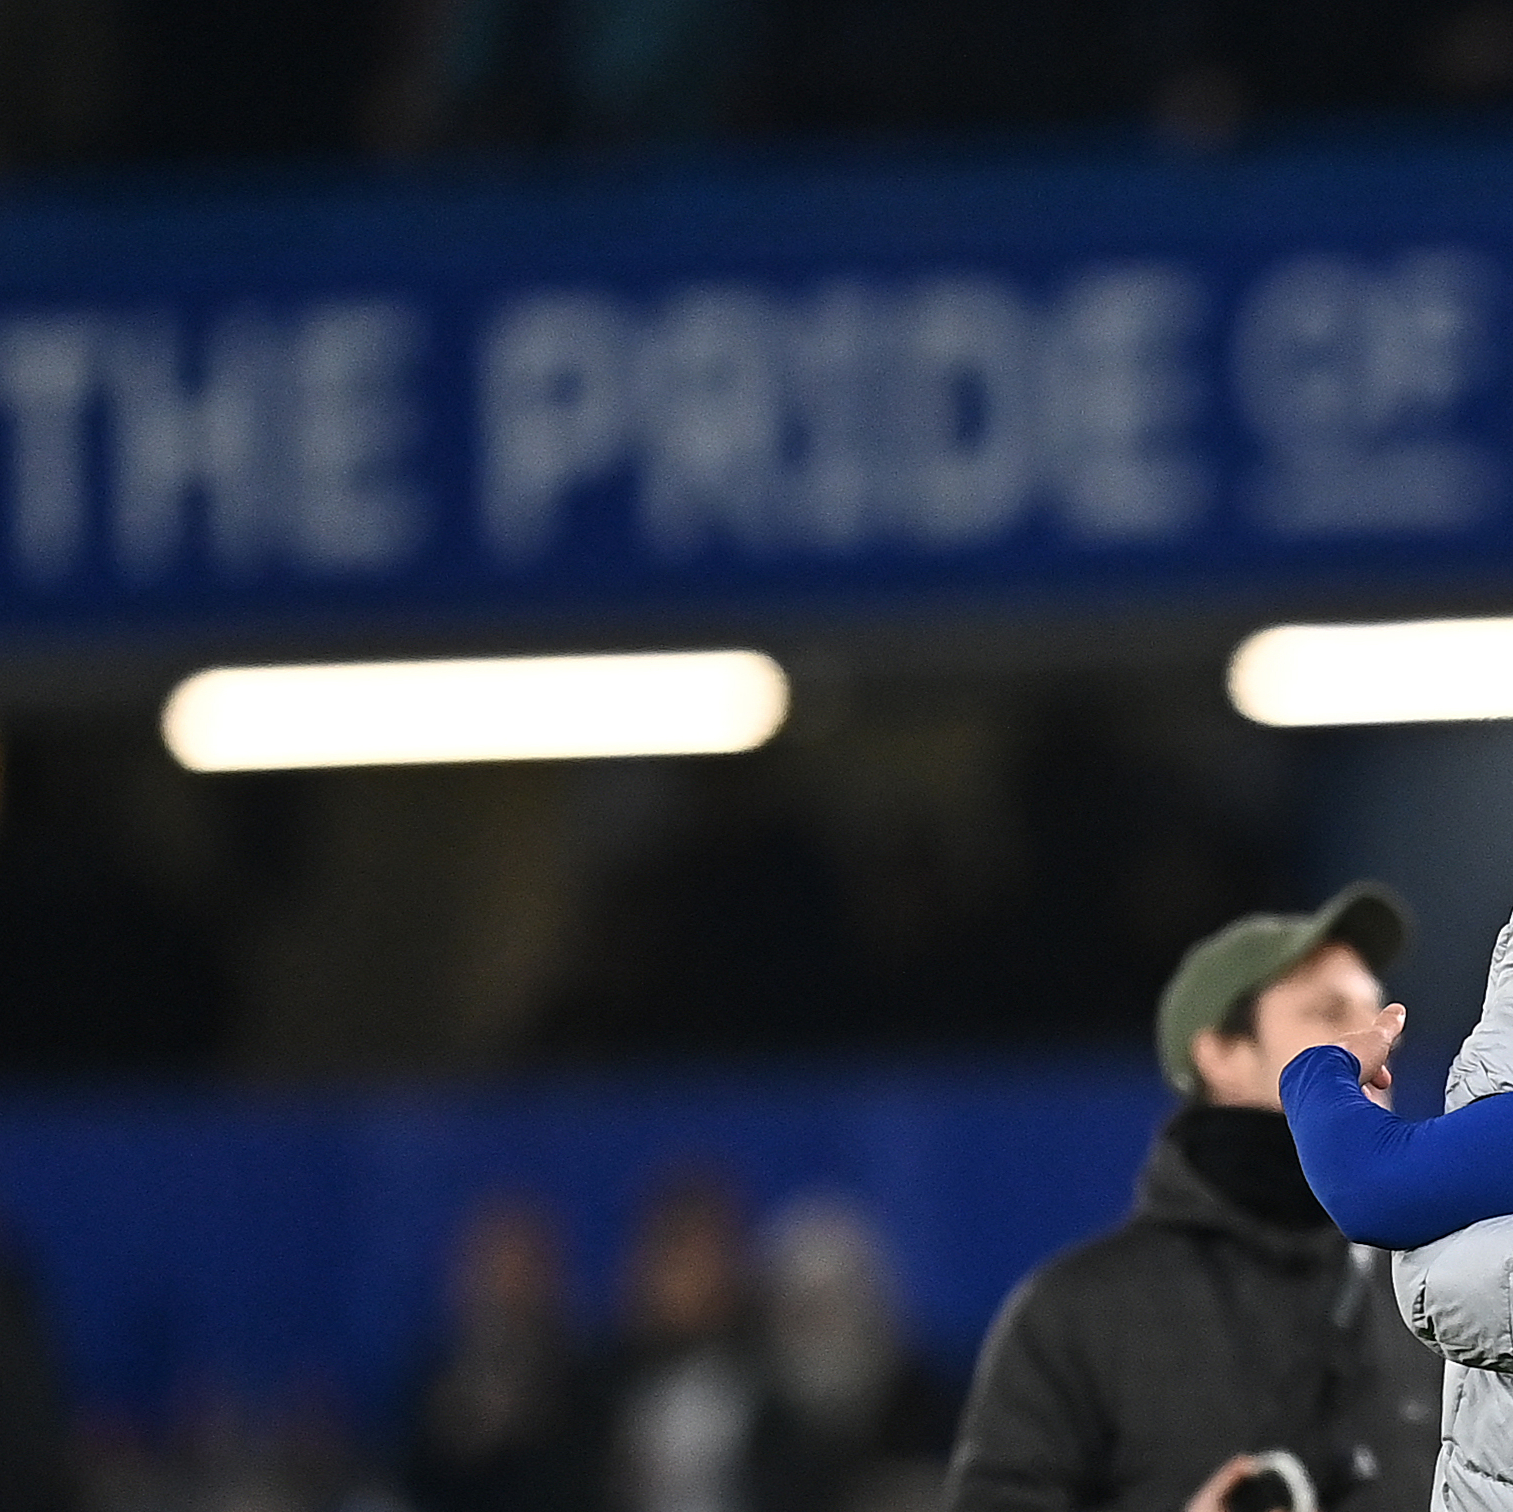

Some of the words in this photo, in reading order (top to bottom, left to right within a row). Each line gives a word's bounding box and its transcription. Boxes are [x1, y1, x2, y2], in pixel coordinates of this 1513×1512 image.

[0, 302, 410, 585] THE
[480, 268, 1200, 560] PRIDE
[1230, 250, 1485, 440] OF
